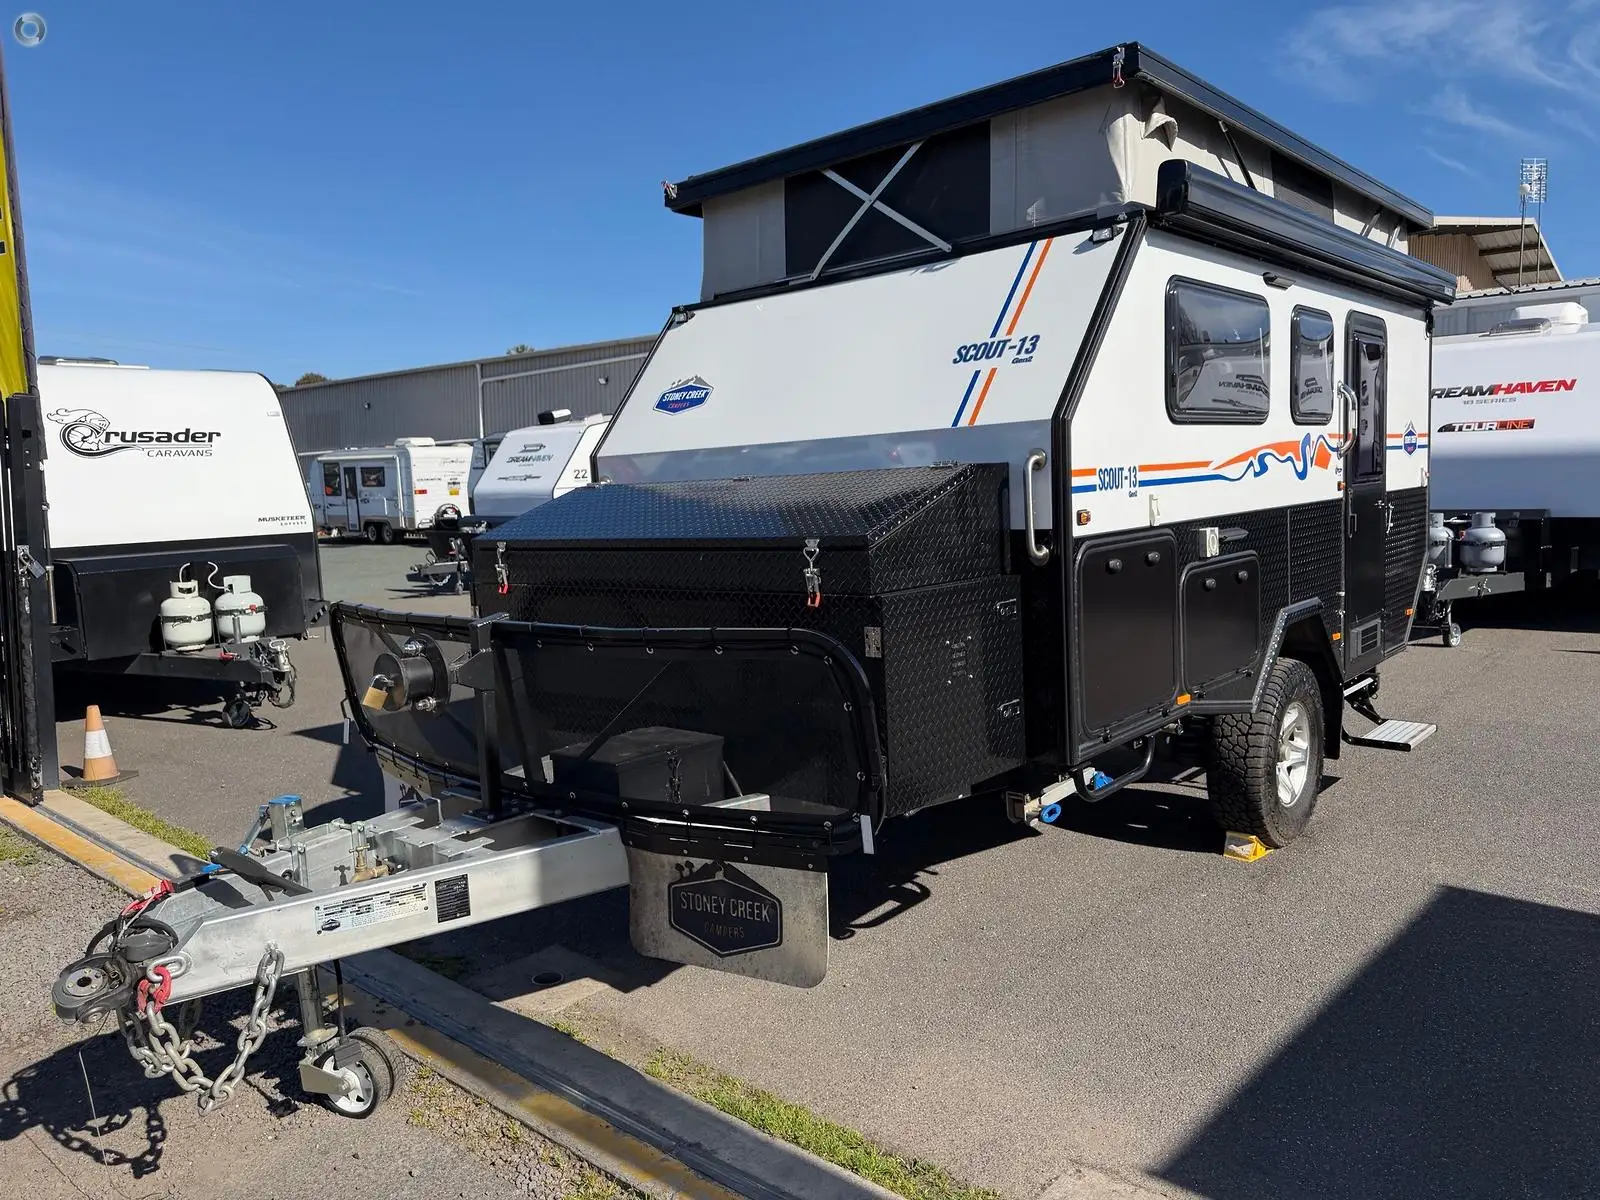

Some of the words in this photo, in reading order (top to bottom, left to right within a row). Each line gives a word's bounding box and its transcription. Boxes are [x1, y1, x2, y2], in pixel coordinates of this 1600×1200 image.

[952, 334, 1040, 364] SCOUT-13
[662, 391, 688, 402] STONEY
[685, 389, 706, 400] CREEK
[1431, 378, 1577, 399] REAMHAVEN
[1452, 419, 1530, 432] TOURLINE
[147, 449, 213, 458] CARAVANS
[573, 469, 588, 479] 22
[1098, 465, 1138, 491] SCOUT-13
[257, 515, 306, 523] MUSKETEER
[679, 891, 726, 916] STONEY
[729, 898, 772, 923] CREEK
[703, 922, 745, 939] CAMPERS
